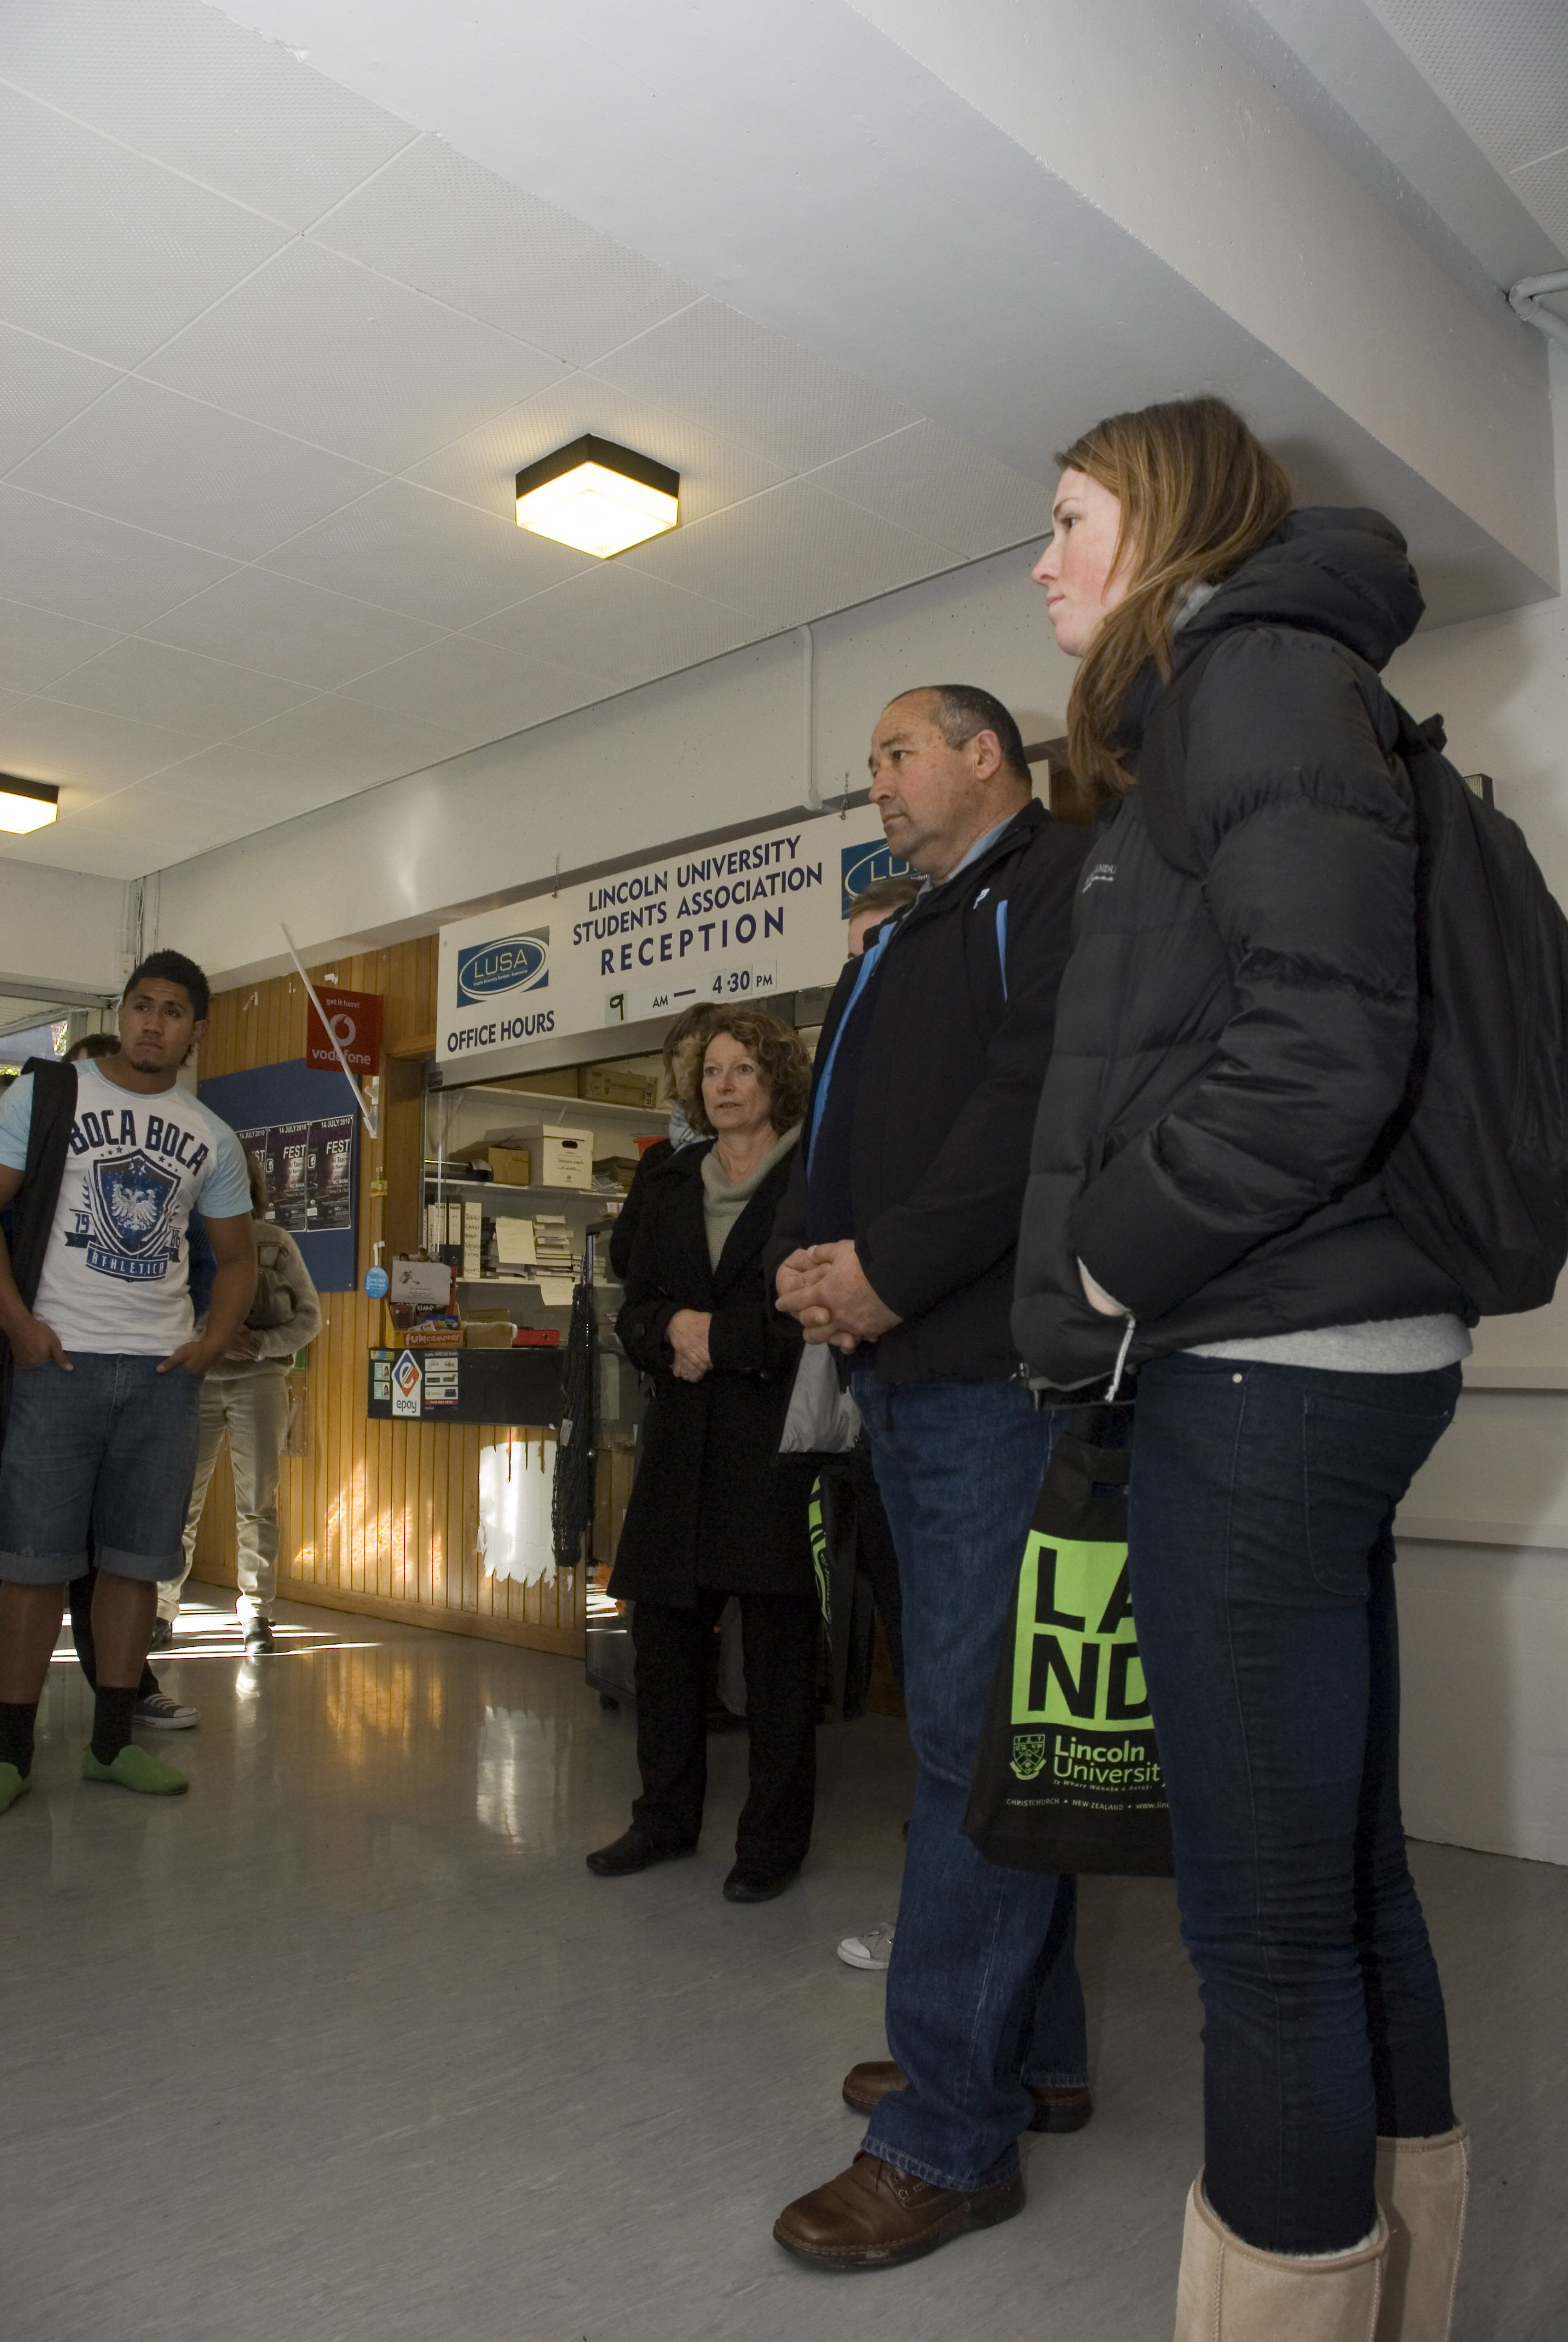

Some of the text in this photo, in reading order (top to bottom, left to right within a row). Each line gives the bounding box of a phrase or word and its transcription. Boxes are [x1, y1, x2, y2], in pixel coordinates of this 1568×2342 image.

[589, 834, 801, 912] LINCOLN UNIVERSITY
[573, 862, 822, 945] STUDENTS ASSOCIATION
[601, 906, 783, 976] RECEPTION
[475, 949, 528, 978] LUSA
[610, 993, 624, 1020] 9
[652, 995, 668, 1008] AM
[756, 974, 773, 987] PM
[447, 1010, 555, 1052] OFFICE HOURS
[69, 1110, 209, 1176] BOCA BOCA
[283, 1144, 306, 1159] FEST
[326, 1139, 350, 1154] FEST
[75, 1213, 89, 1234] 19
[92, 1249, 164, 1275] ATHLETICA
[396, 1400, 417, 1413] epay
[1055, 1735, 1145, 1763] Lincoln
[1053, 1756, 1166, 1788] Universit
[1063, 1780, 1087, 1789] Whare
[1006, 1798, 1060, 1807] CHRISTCHURCH
[1072, 1799, 1089, 1808] NEW
[1091, 1802, 1124, 1811] ZEALAND
